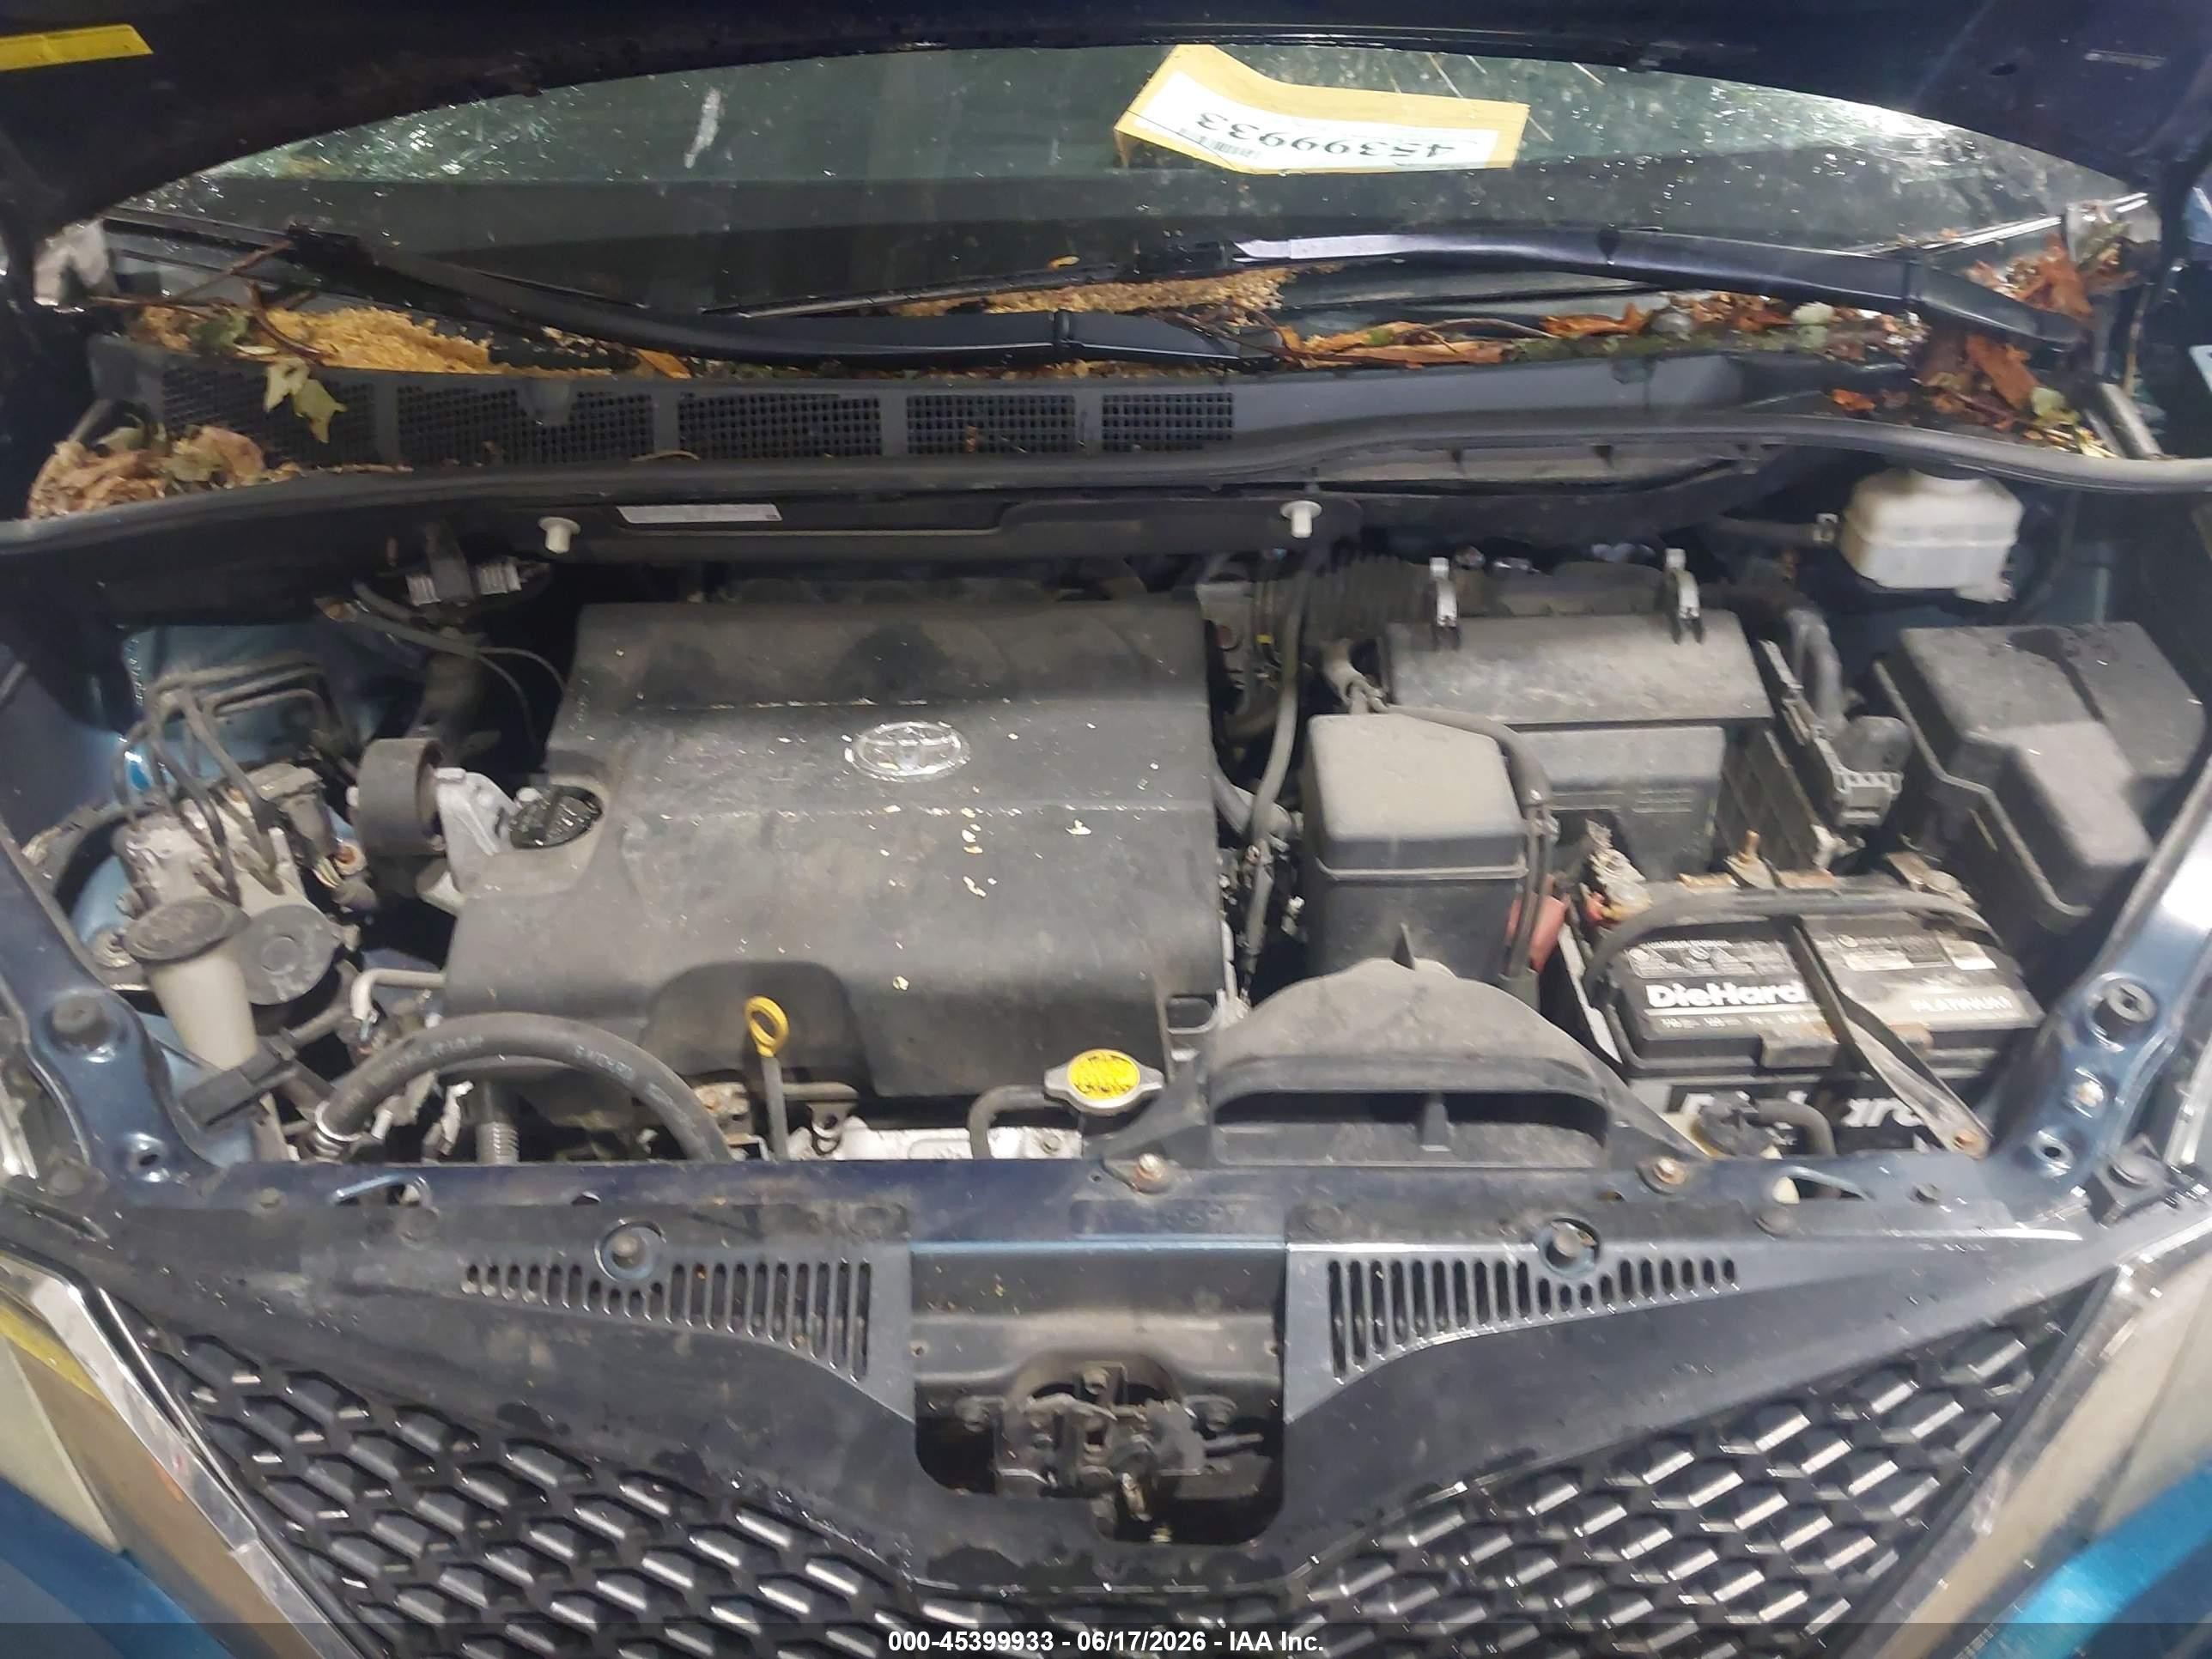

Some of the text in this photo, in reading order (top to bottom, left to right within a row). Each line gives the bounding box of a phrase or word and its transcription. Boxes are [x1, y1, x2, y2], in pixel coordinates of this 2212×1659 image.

[1196, 112, 1455, 158] 45399933
[1644, 980, 1808, 1008] DieHard
[1909, 995, 2014, 1012] PLATINUM
